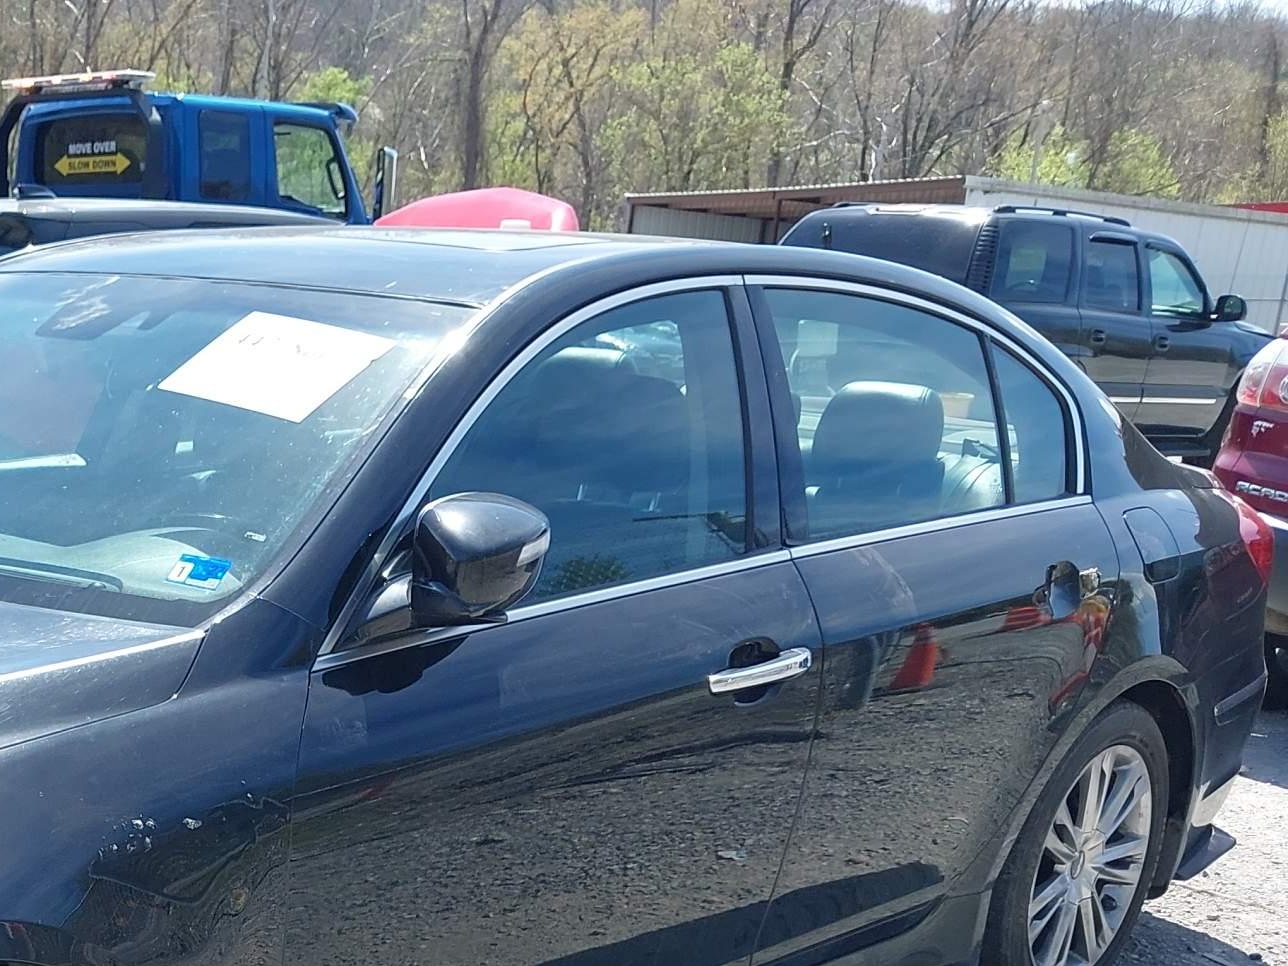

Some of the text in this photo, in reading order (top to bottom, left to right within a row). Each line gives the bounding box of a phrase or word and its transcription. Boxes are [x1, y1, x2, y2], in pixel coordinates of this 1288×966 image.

[68, 140, 116, 155] MOVE OVER
[68, 159, 116, 170] SLOW DOWN
[176, 565, 186, 578] 1
